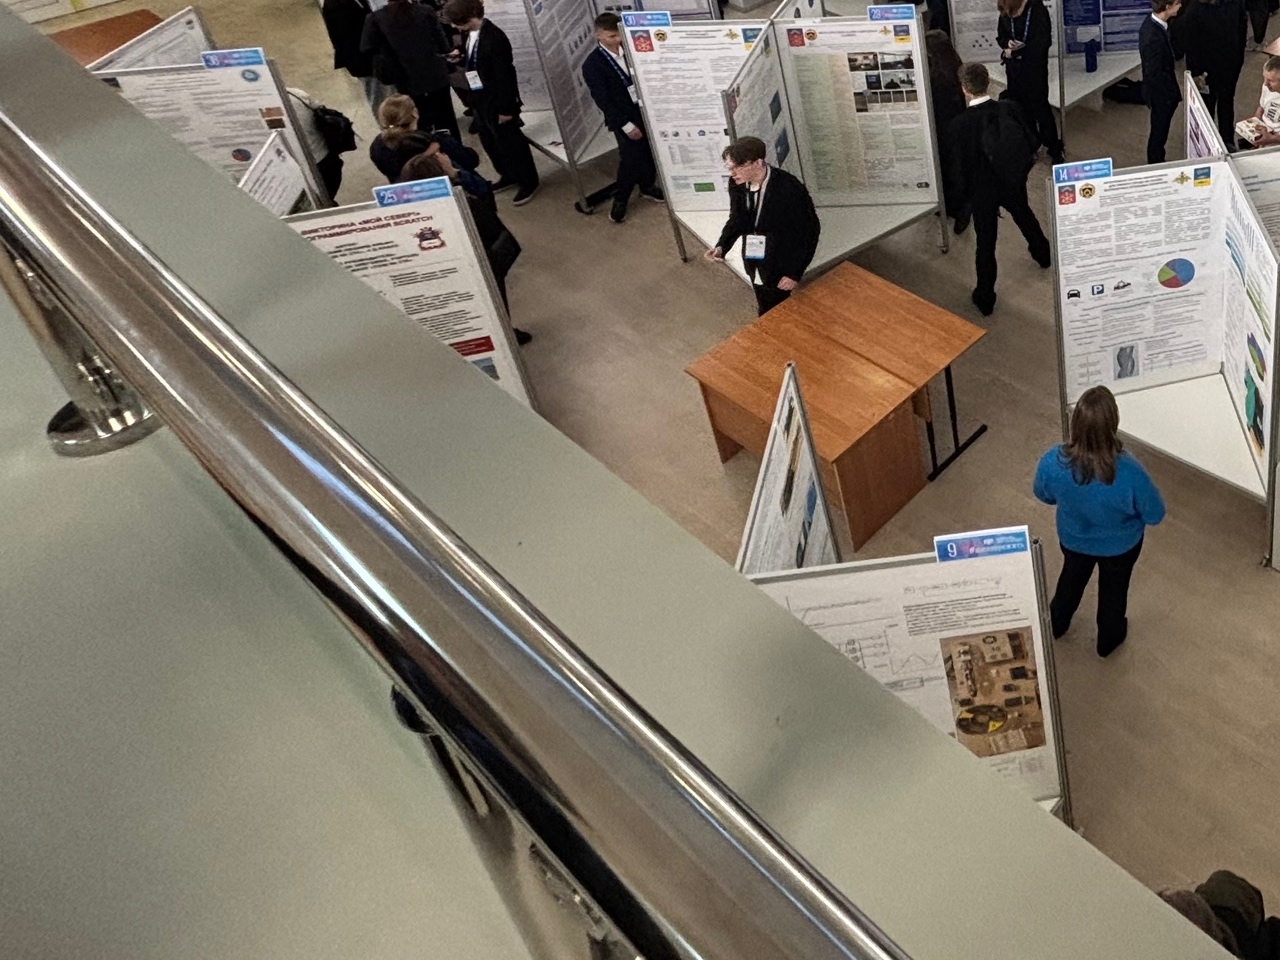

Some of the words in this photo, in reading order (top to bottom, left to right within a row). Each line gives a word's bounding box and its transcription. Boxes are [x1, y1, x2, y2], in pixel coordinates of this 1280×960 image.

[1059, 169, 1068, 181] 14
[380, 190, 398, 204] 25
[301, 220, 356, 236] ВИКТОРИНА
[393, 215, 433, 227] SCRATCH
[947, 542, 957, 558] 9
